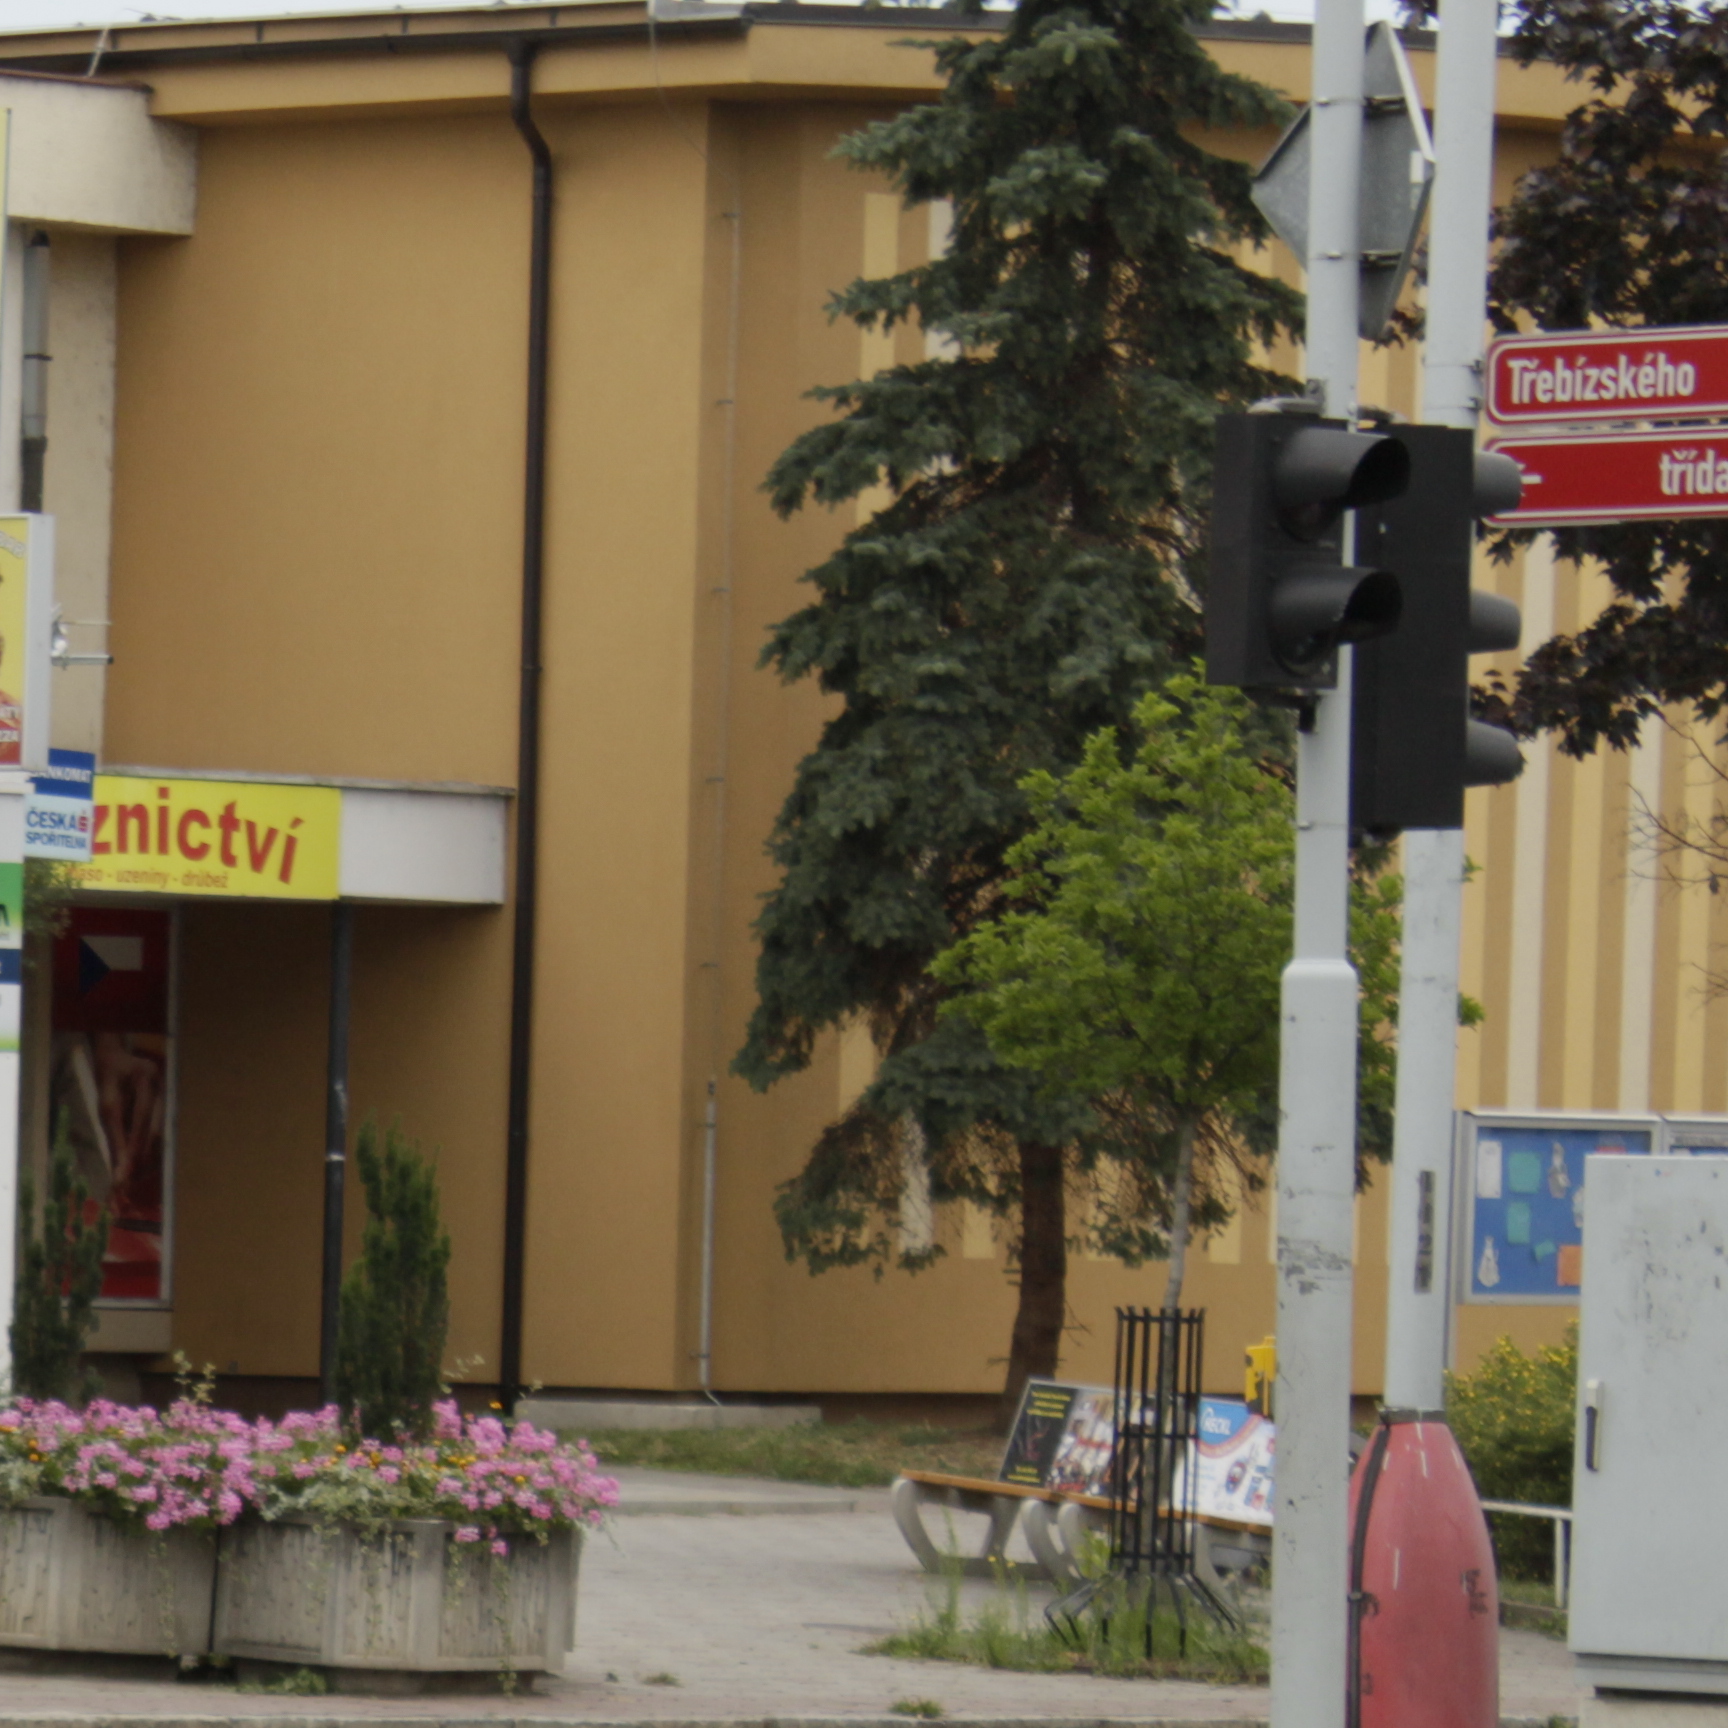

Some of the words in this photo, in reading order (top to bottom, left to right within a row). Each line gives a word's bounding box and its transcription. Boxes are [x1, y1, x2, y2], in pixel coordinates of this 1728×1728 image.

[1506, 354, 1695, 405] Třebízského
[29, 766, 92, 784] NKOMAT
[26, 831, 86, 849] SPOŘITELNA
